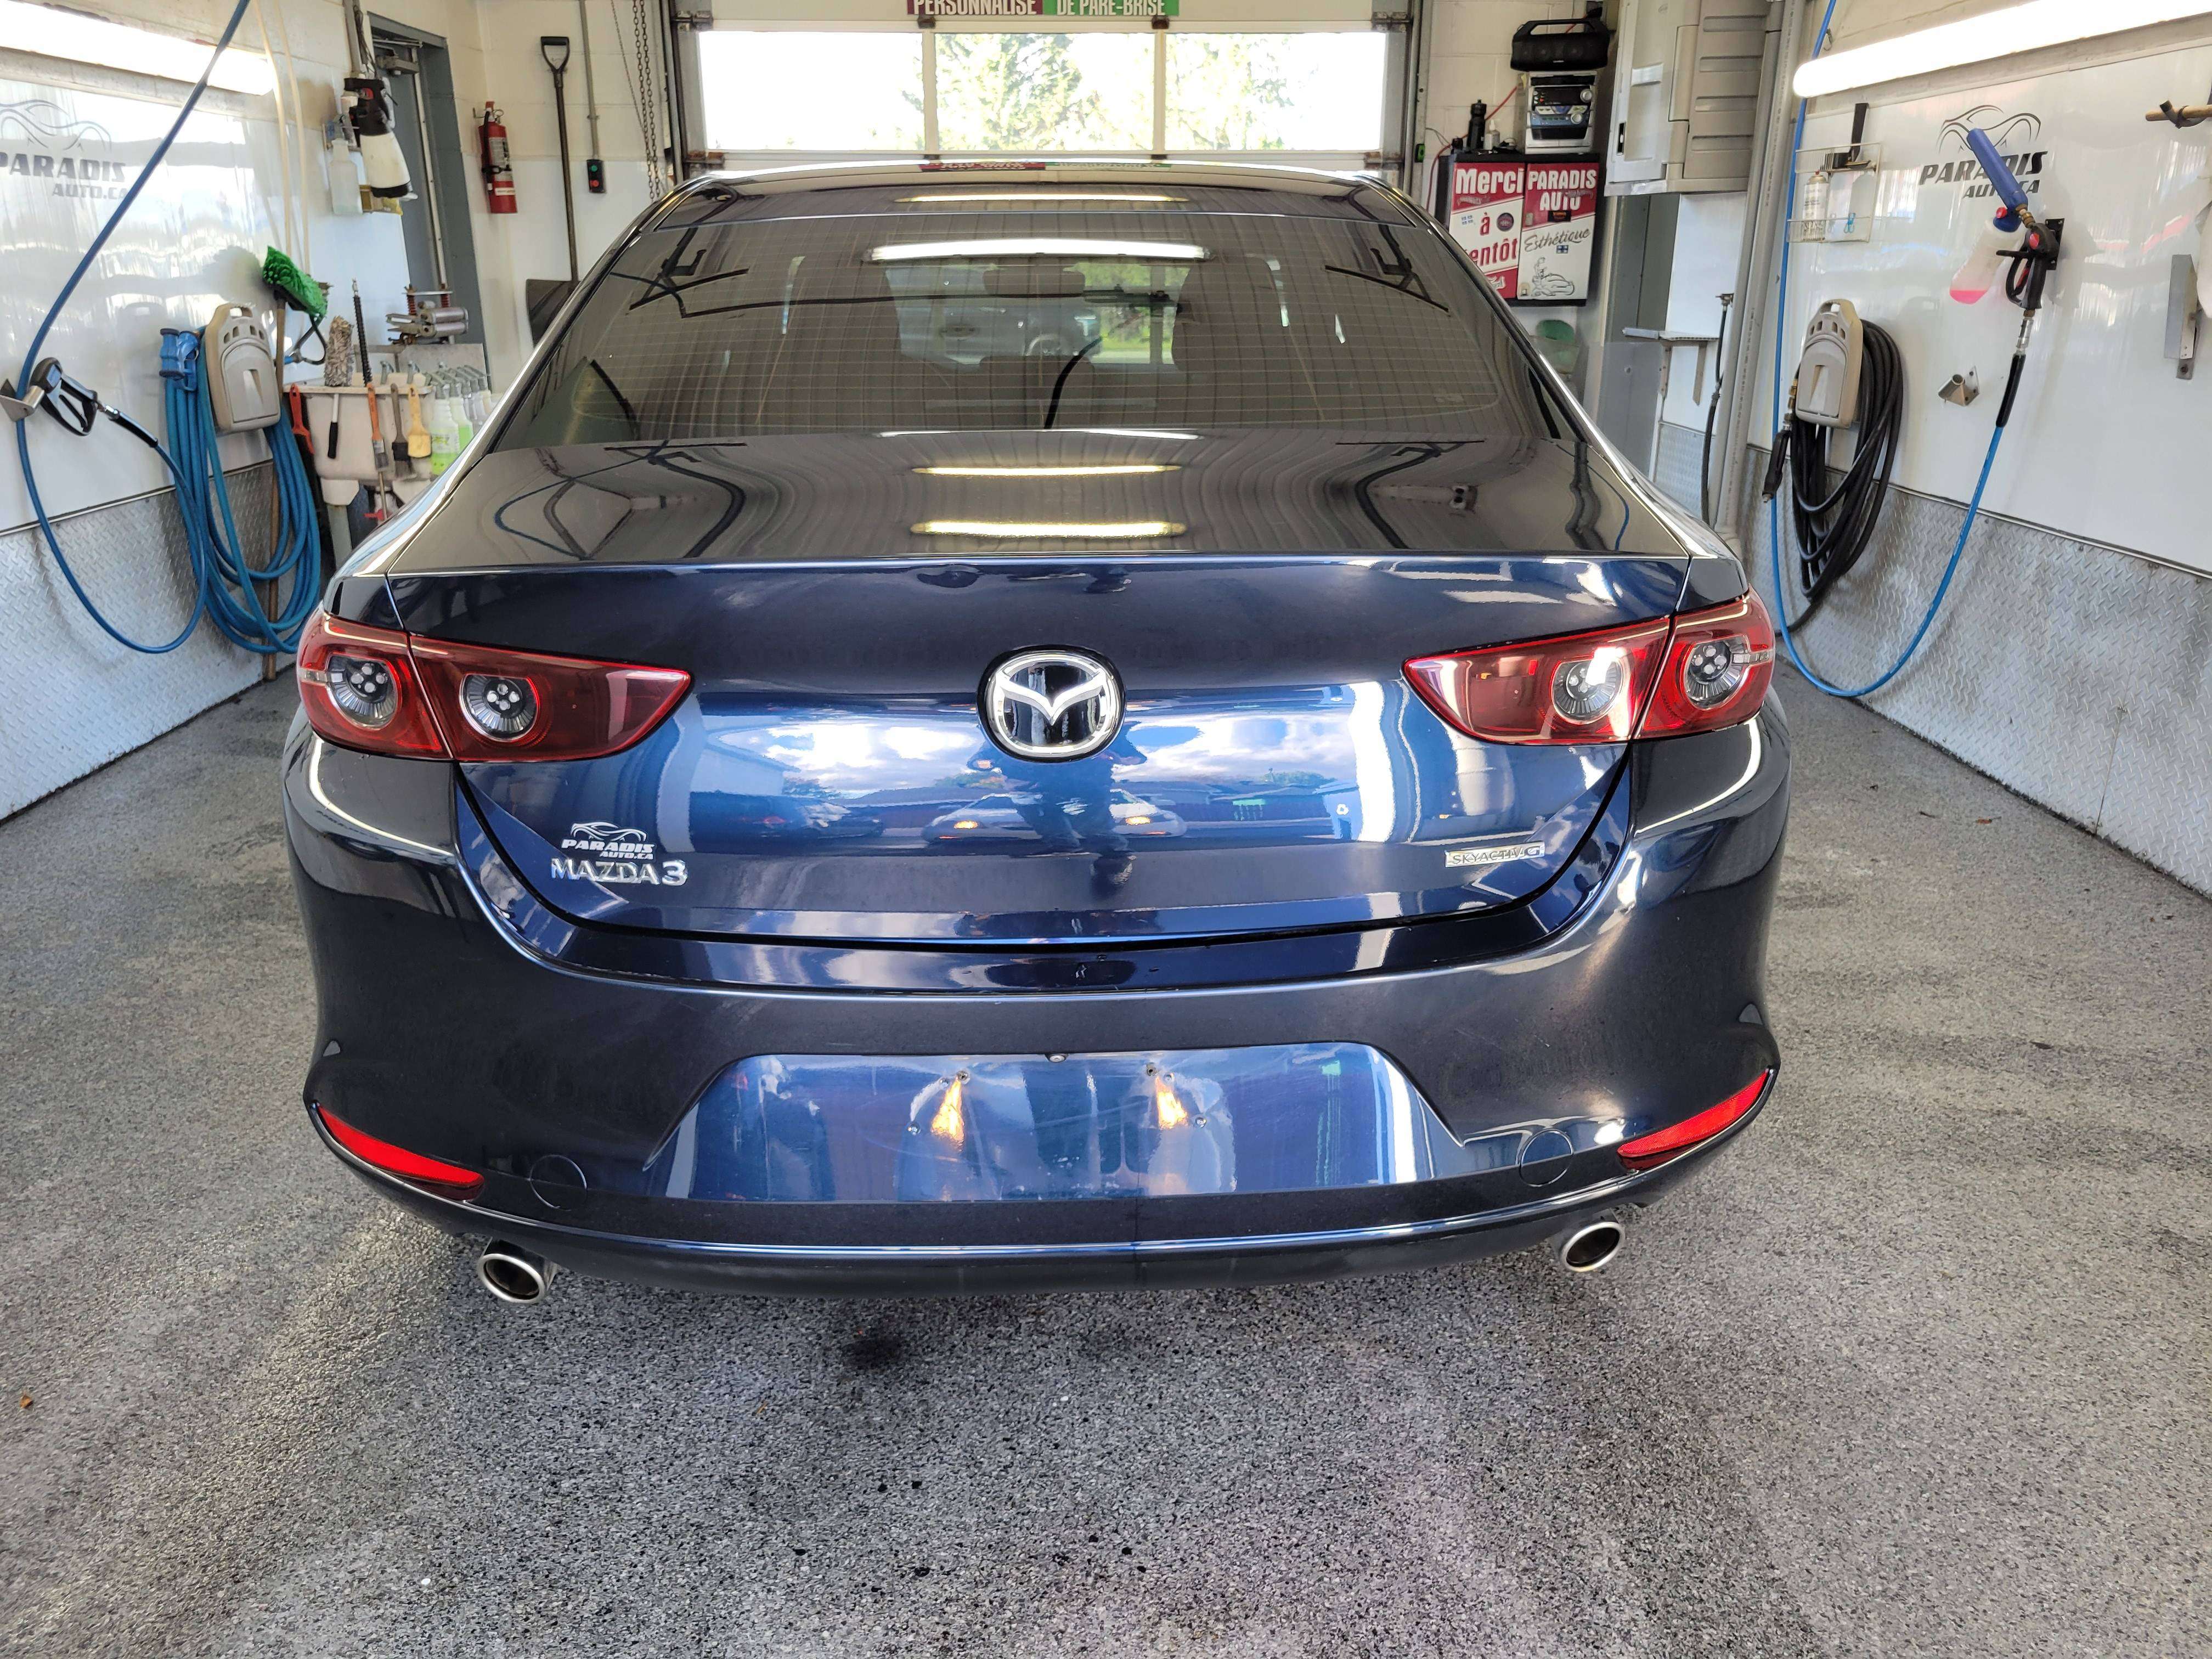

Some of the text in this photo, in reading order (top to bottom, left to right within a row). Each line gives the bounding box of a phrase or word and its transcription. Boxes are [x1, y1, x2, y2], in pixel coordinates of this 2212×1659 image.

[1057, 0, 1166, 16] DE PARE-BRISE
[1455, 167, 1525, 194] Merci
[1527, 169, 1597, 190] PARADIS
[1539, 191, 1581, 211] AUTO
[1480, 211, 1490, 236] à
[1524, 228, 1590, 252] Esthétique
[1469, 238, 1518, 267] entôt
[561, 839, 655, 854] PARADIS
[599, 851, 654, 860] AUTO.CA
[550, 857, 688, 887] MAZDA 3
